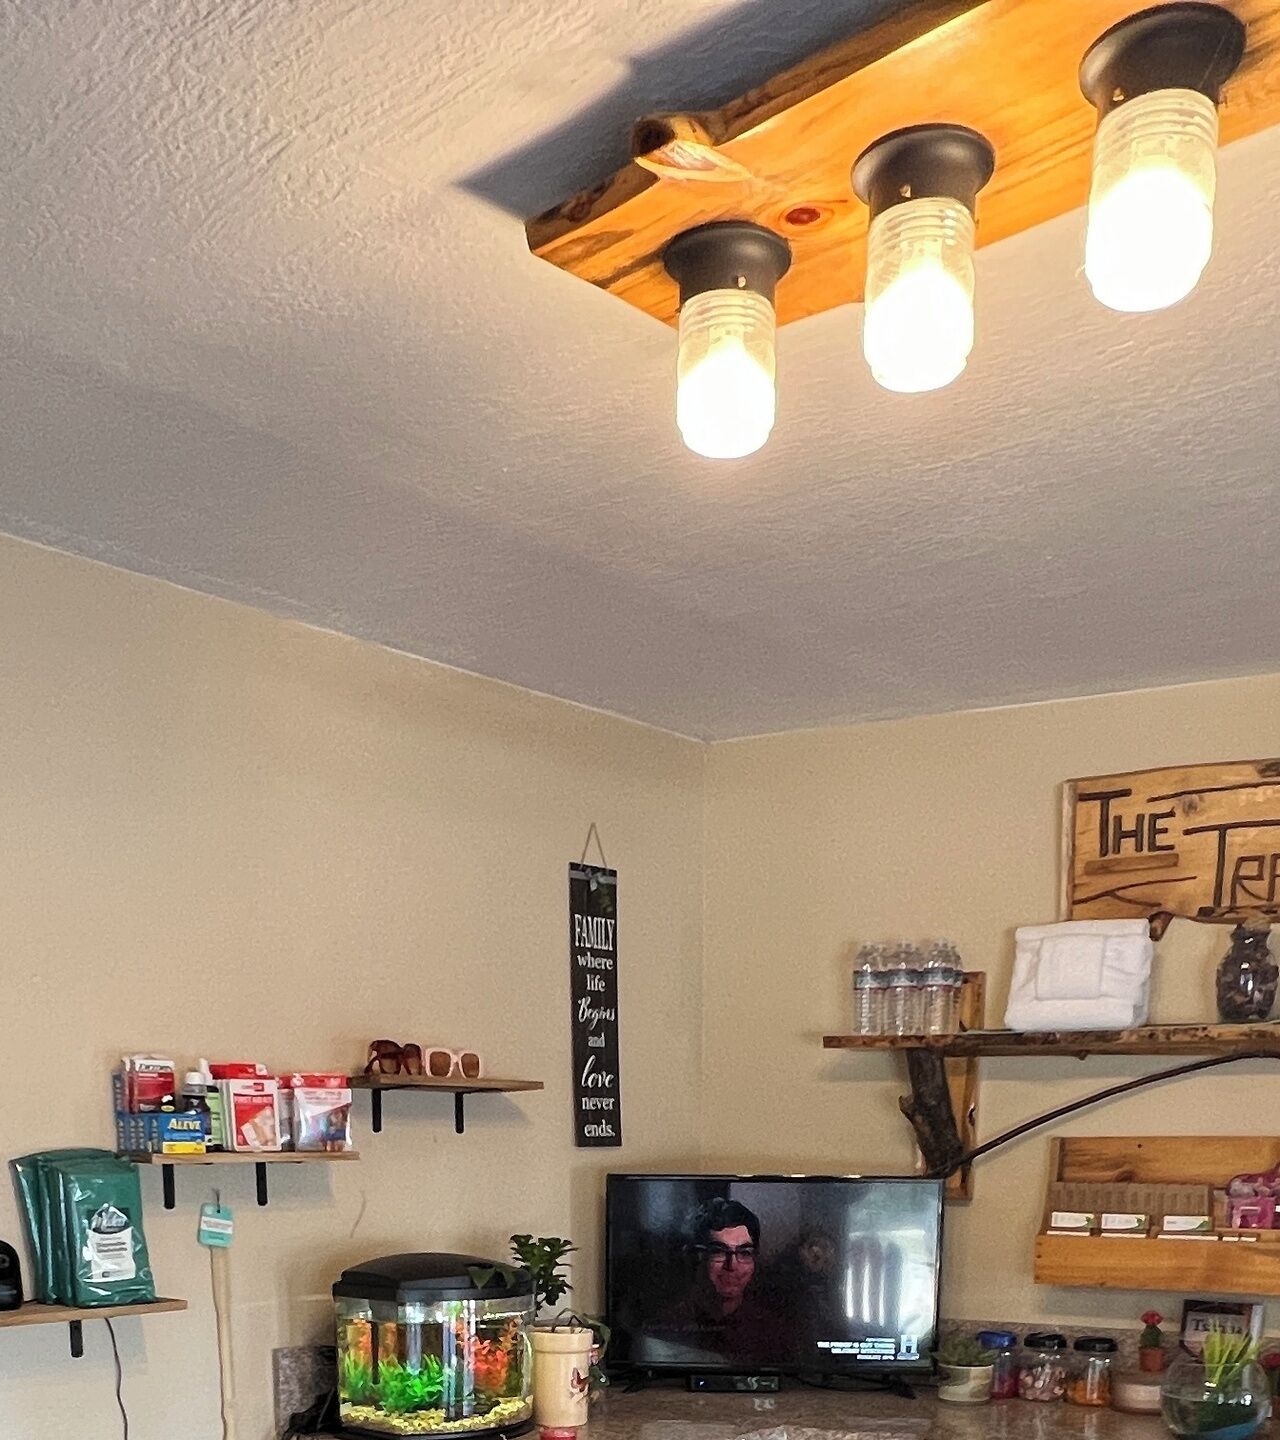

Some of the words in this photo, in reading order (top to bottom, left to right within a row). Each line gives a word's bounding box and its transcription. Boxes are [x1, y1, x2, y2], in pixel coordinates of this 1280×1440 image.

[1077, 787, 1177, 858] THE
[574, 913, 615, 951] FAMILY
[577, 953, 614, 970] where
[586, 974, 606, 992] life
[577, 996, 615, 1030] Begins
[588, 1033, 606, 1048] and
[581, 1055, 615, 1088] love
[582, 1096, 615, 1111] never
[584, 1123, 616, 1137] ends.
